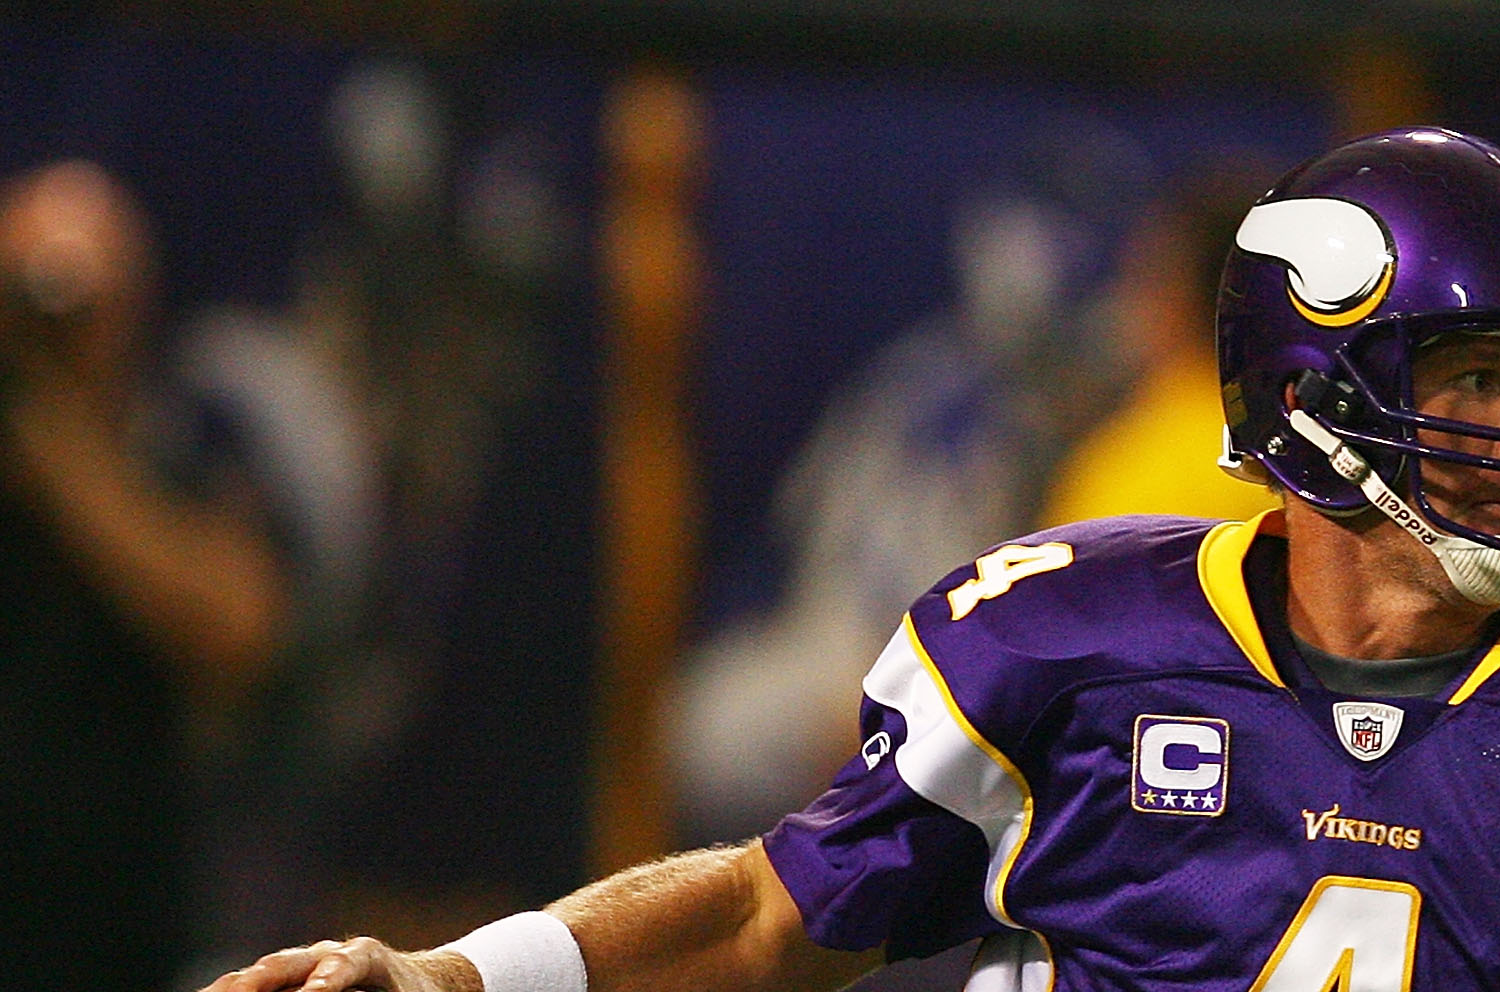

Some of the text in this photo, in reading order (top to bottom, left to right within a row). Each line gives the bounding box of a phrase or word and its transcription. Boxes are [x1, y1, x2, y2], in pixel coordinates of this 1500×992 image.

[1374, 490, 1439, 546] Riddell
[946, 541, 1075, 623] 4
[1139, 722, 1223, 792] C
[1352, 730, 1382, 751] NFL
